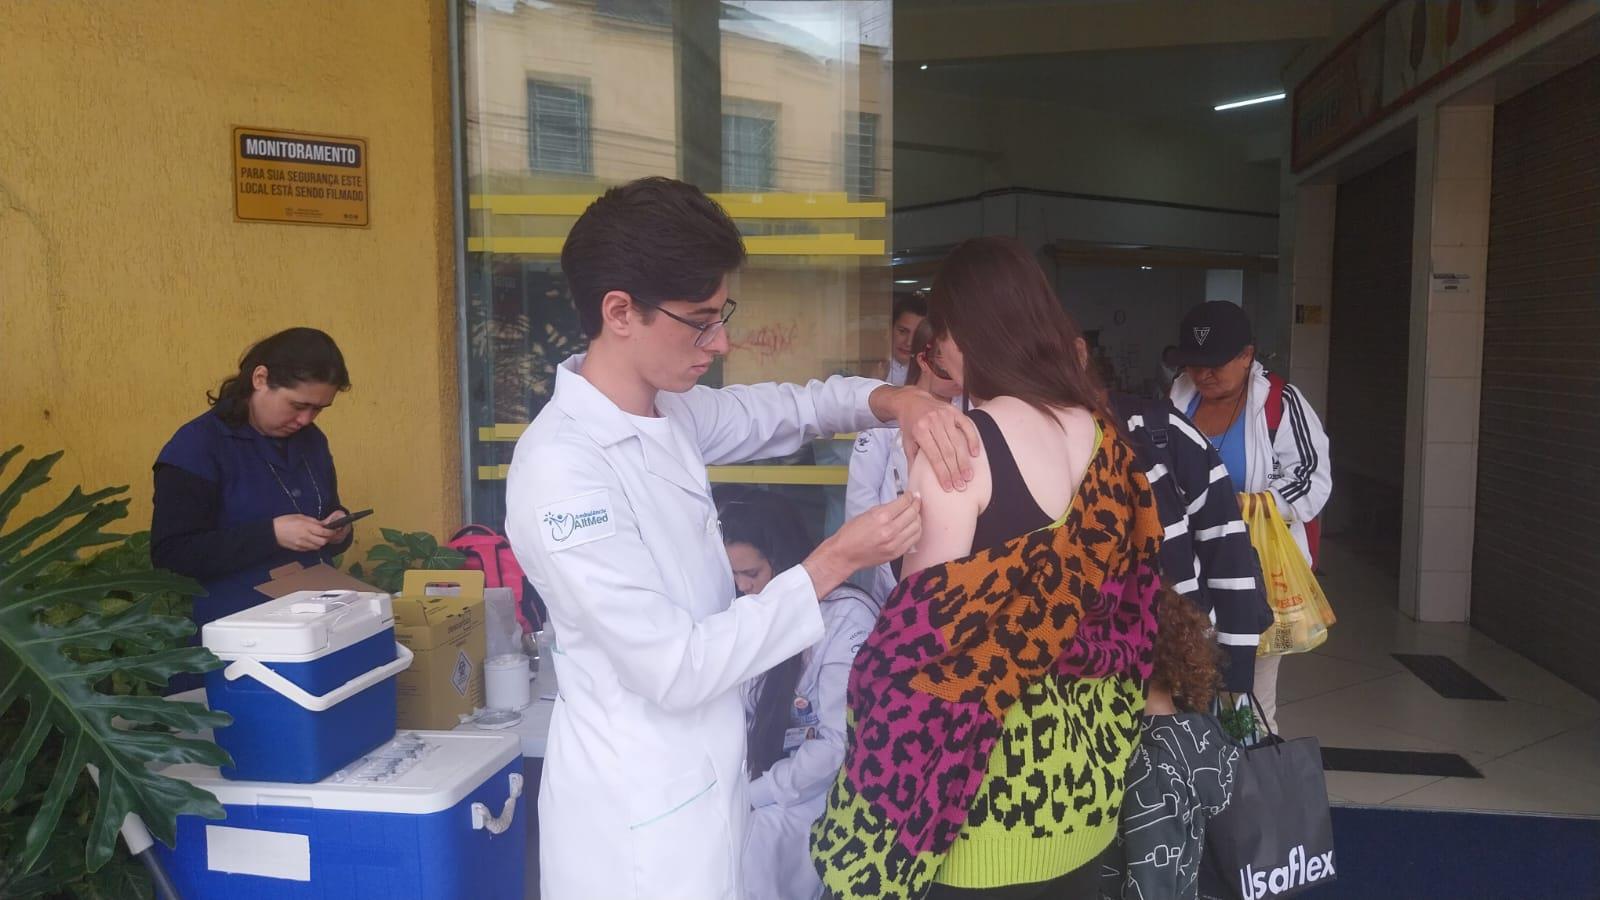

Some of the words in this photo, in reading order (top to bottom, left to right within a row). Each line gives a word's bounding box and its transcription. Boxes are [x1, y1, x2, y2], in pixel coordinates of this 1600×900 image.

[246, 138, 356, 164] MONITORAMENTO
[240, 167, 265, 180] PARA
[266, 168, 285, 181] SUA
[287, 170, 339, 187] SEGURANÇA
[341, 175, 363, 188] ESTE
[240, 181, 269, 195] LOCAL
[271, 183, 293, 197] ESTÁ
[295, 185, 325, 199] SENDO
[326, 188, 364, 202] FILMADO
[574, 513, 609, 530] AltMed
[1239, 844, 1336, 900] Usaflex
